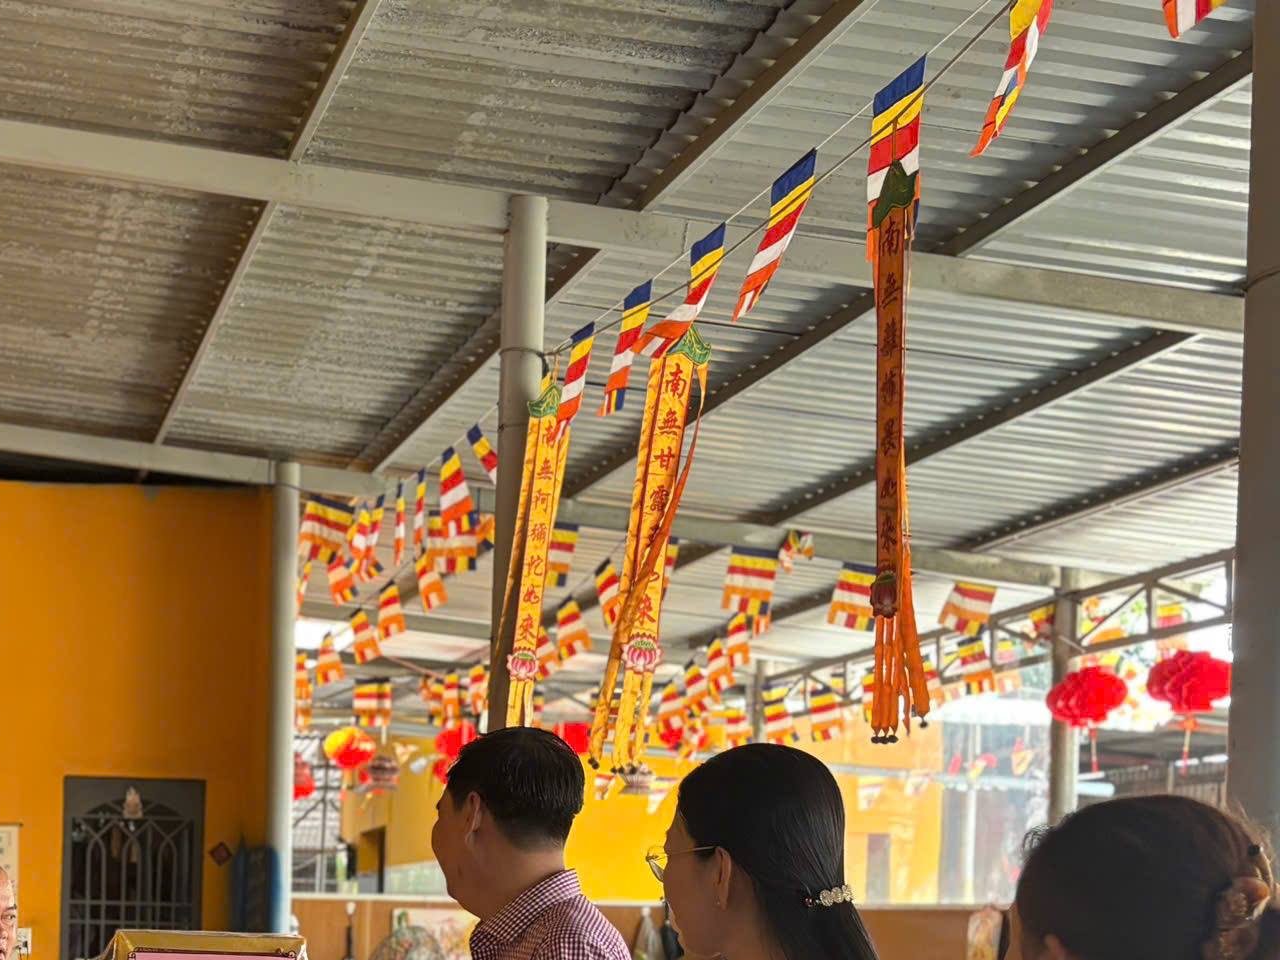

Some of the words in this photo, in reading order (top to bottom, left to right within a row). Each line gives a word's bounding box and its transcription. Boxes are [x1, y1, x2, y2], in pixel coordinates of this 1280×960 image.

[636, 362, 687, 626] 南無甘露來
